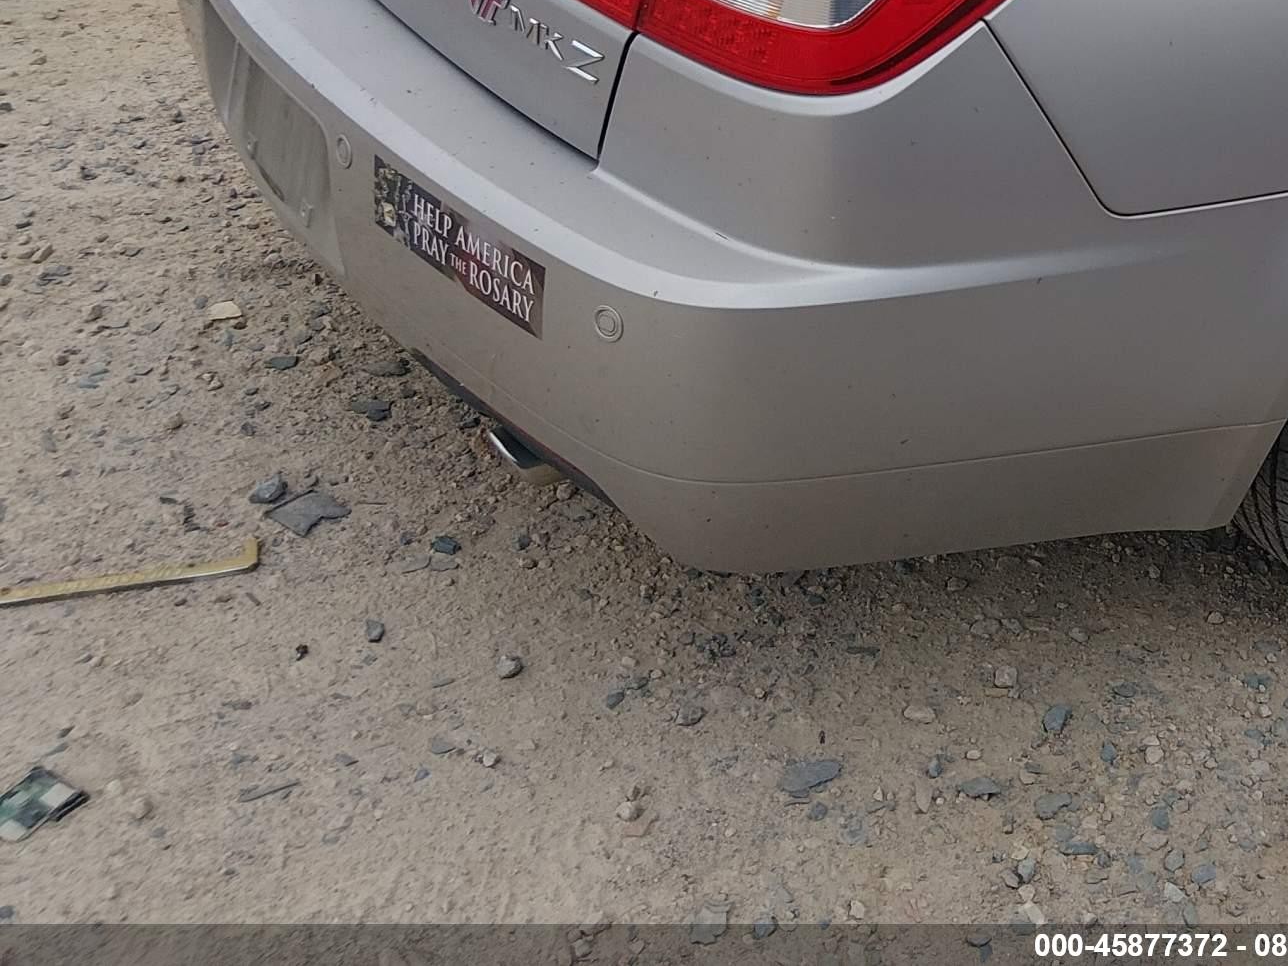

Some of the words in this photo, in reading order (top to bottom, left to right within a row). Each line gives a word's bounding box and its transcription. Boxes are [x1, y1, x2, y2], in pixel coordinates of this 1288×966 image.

[510, 4, 606, 85] MKZ
[412, 193, 453, 239] HELP
[454, 224, 536, 296] AMERICA
[412, 219, 450, 267] PRAY
[450, 253, 468, 276] THE
[468, 260, 535, 324] ROSARY
